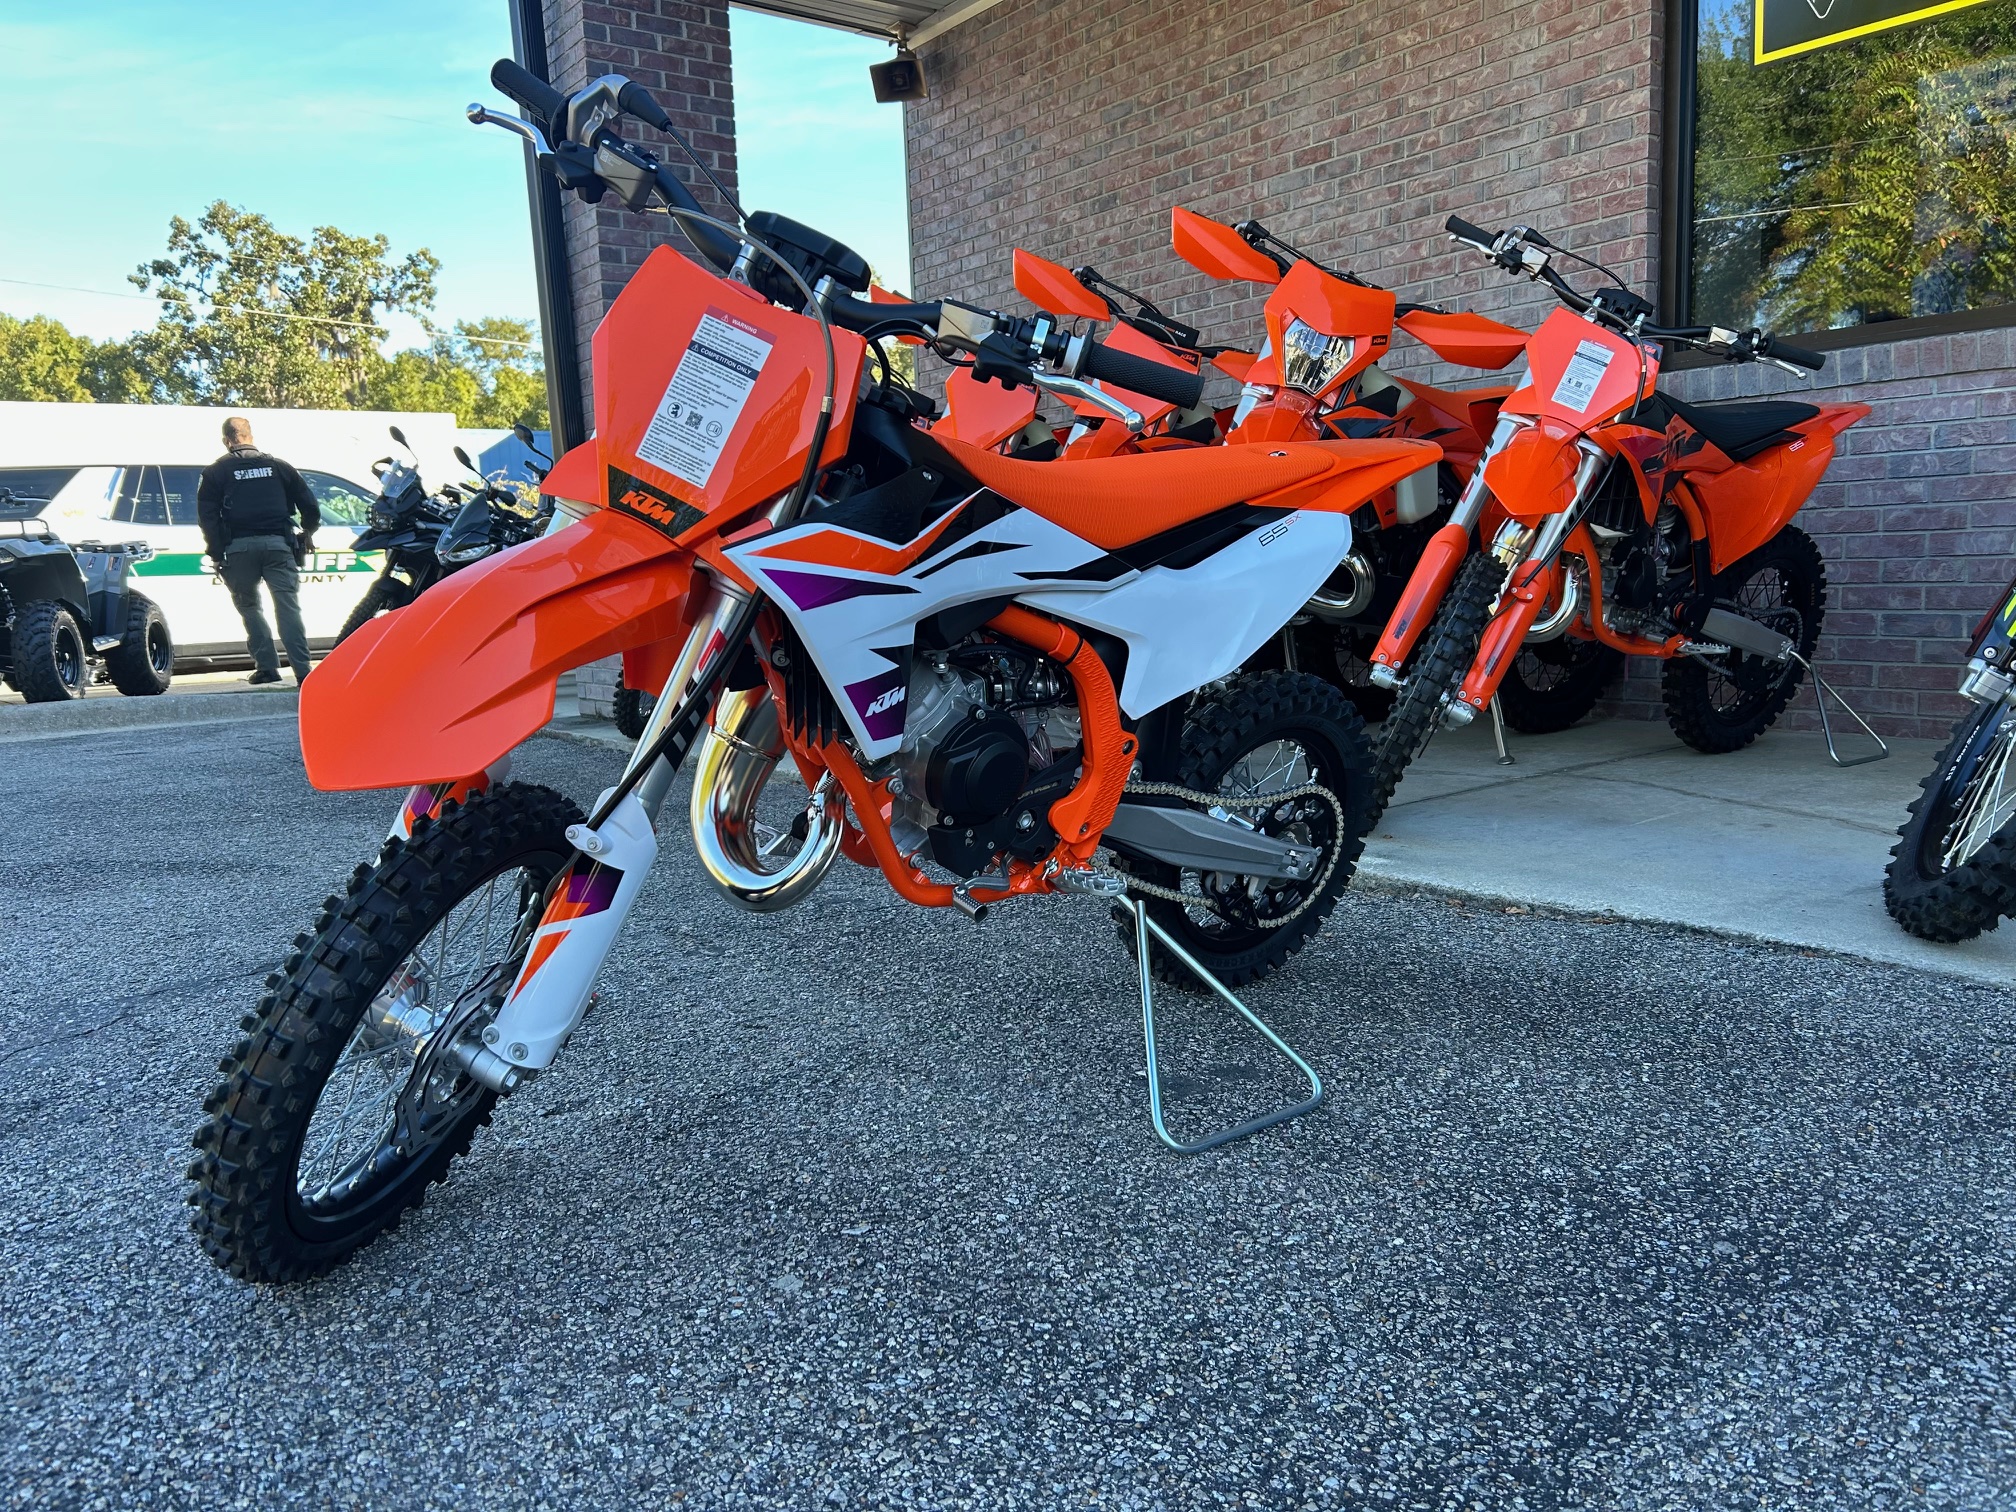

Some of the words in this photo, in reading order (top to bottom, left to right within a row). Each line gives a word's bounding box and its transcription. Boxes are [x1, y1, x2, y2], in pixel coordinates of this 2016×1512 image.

[731, 318, 757, 334] WARNING
[699, 346, 737, 368] COMPETITION
[735, 363, 752, 375] ONLY
[619, 490, 677, 527] KTM
[1258, 522, 1289, 547] 65
[200, 553, 357, 574] SIFF
[864, 685, 907, 718] KTM
